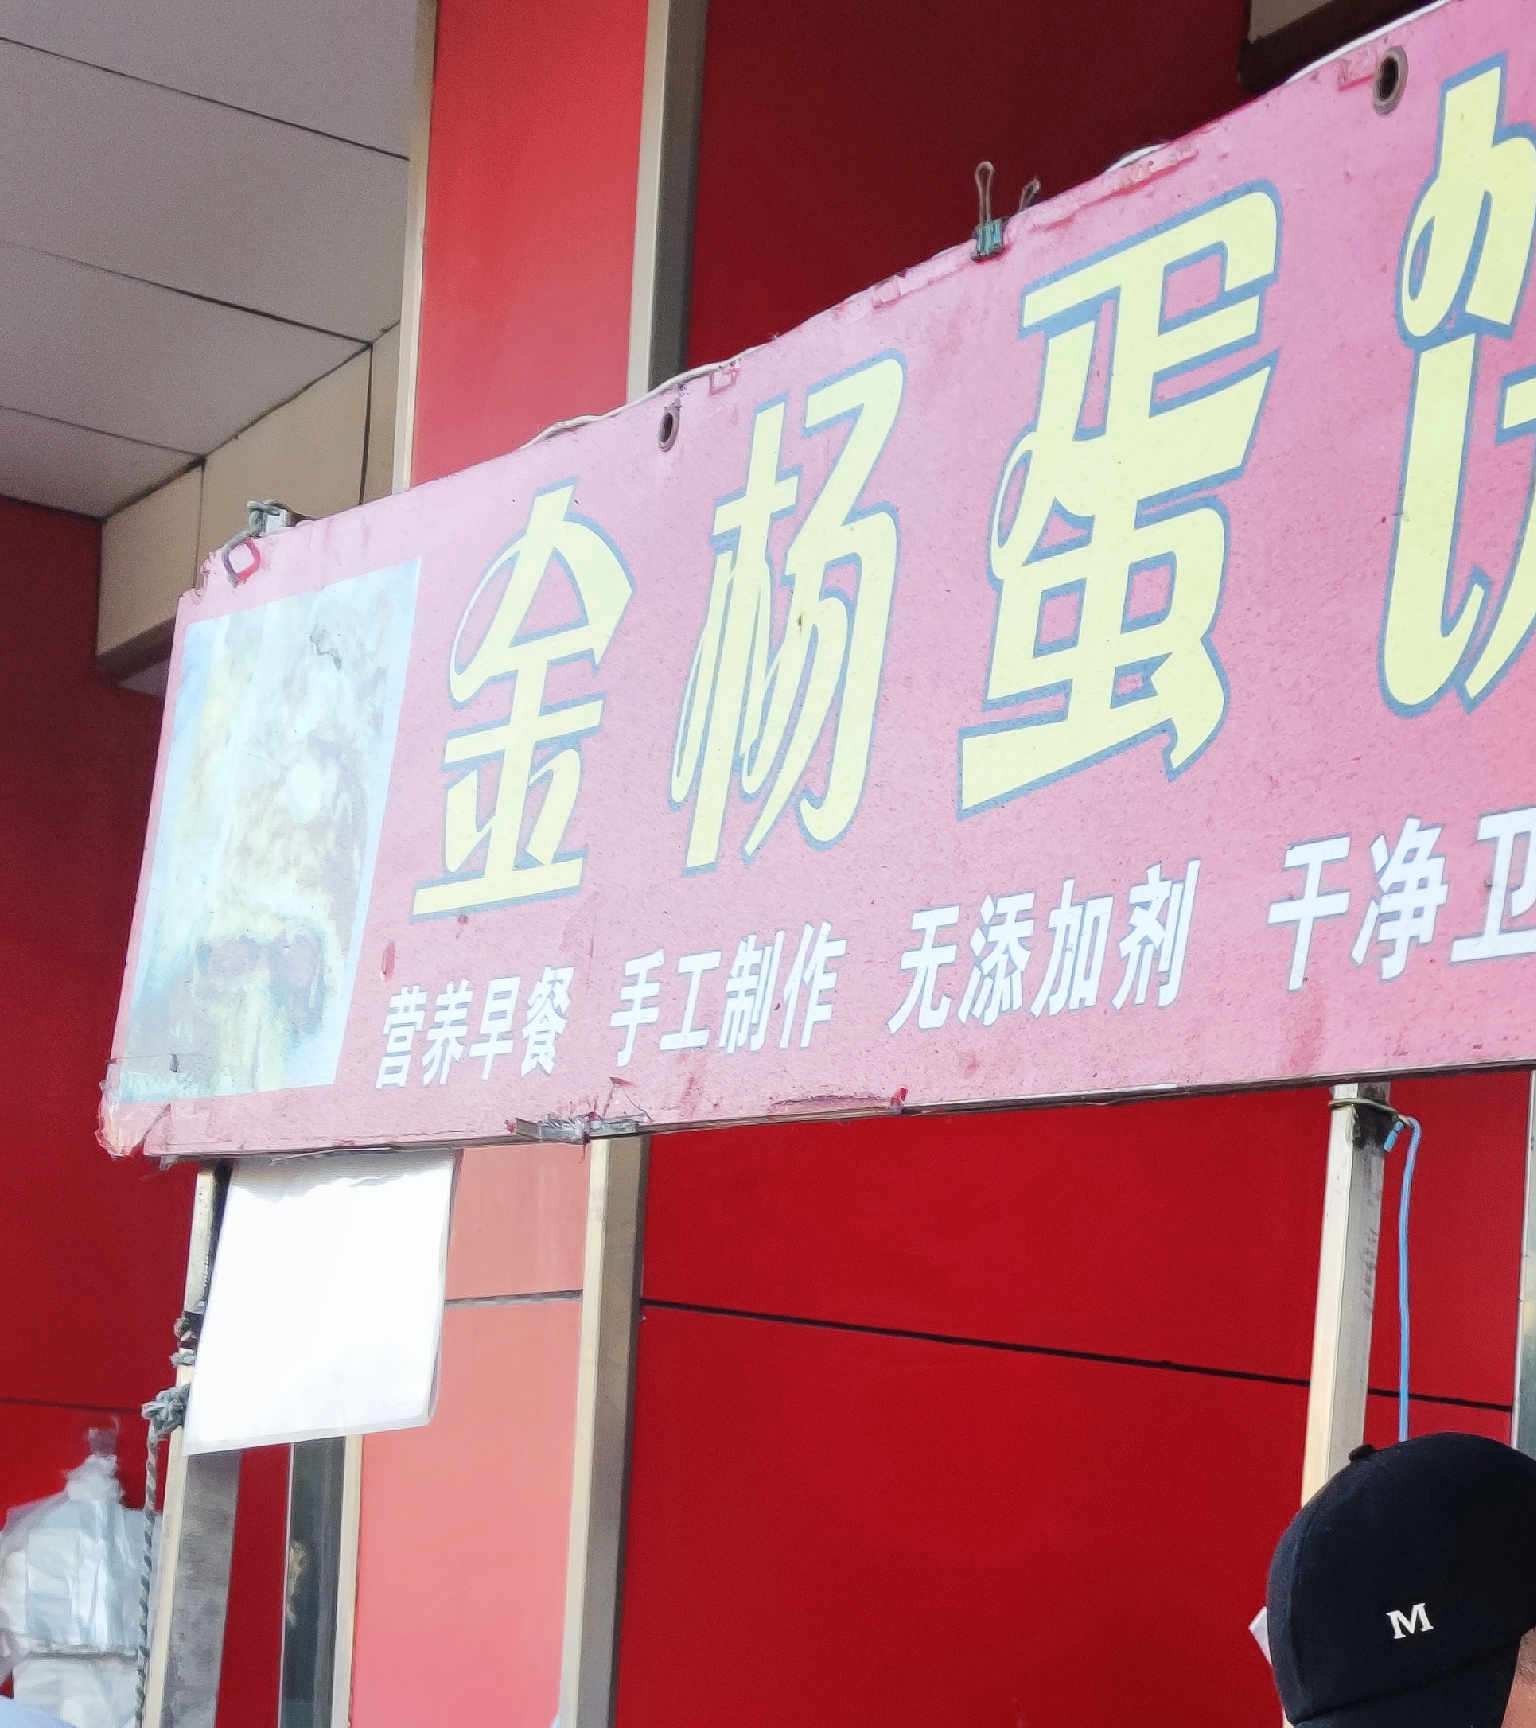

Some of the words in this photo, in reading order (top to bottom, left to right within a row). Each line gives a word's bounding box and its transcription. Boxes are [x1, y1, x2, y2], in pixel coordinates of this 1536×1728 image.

[375, 966, 573, 1090] 营养早餐
[609, 919, 847, 1067] 手工制作
[888, 857, 1201, 1034] 无添加剂
[1386, 1602, 1435, 1640] M
